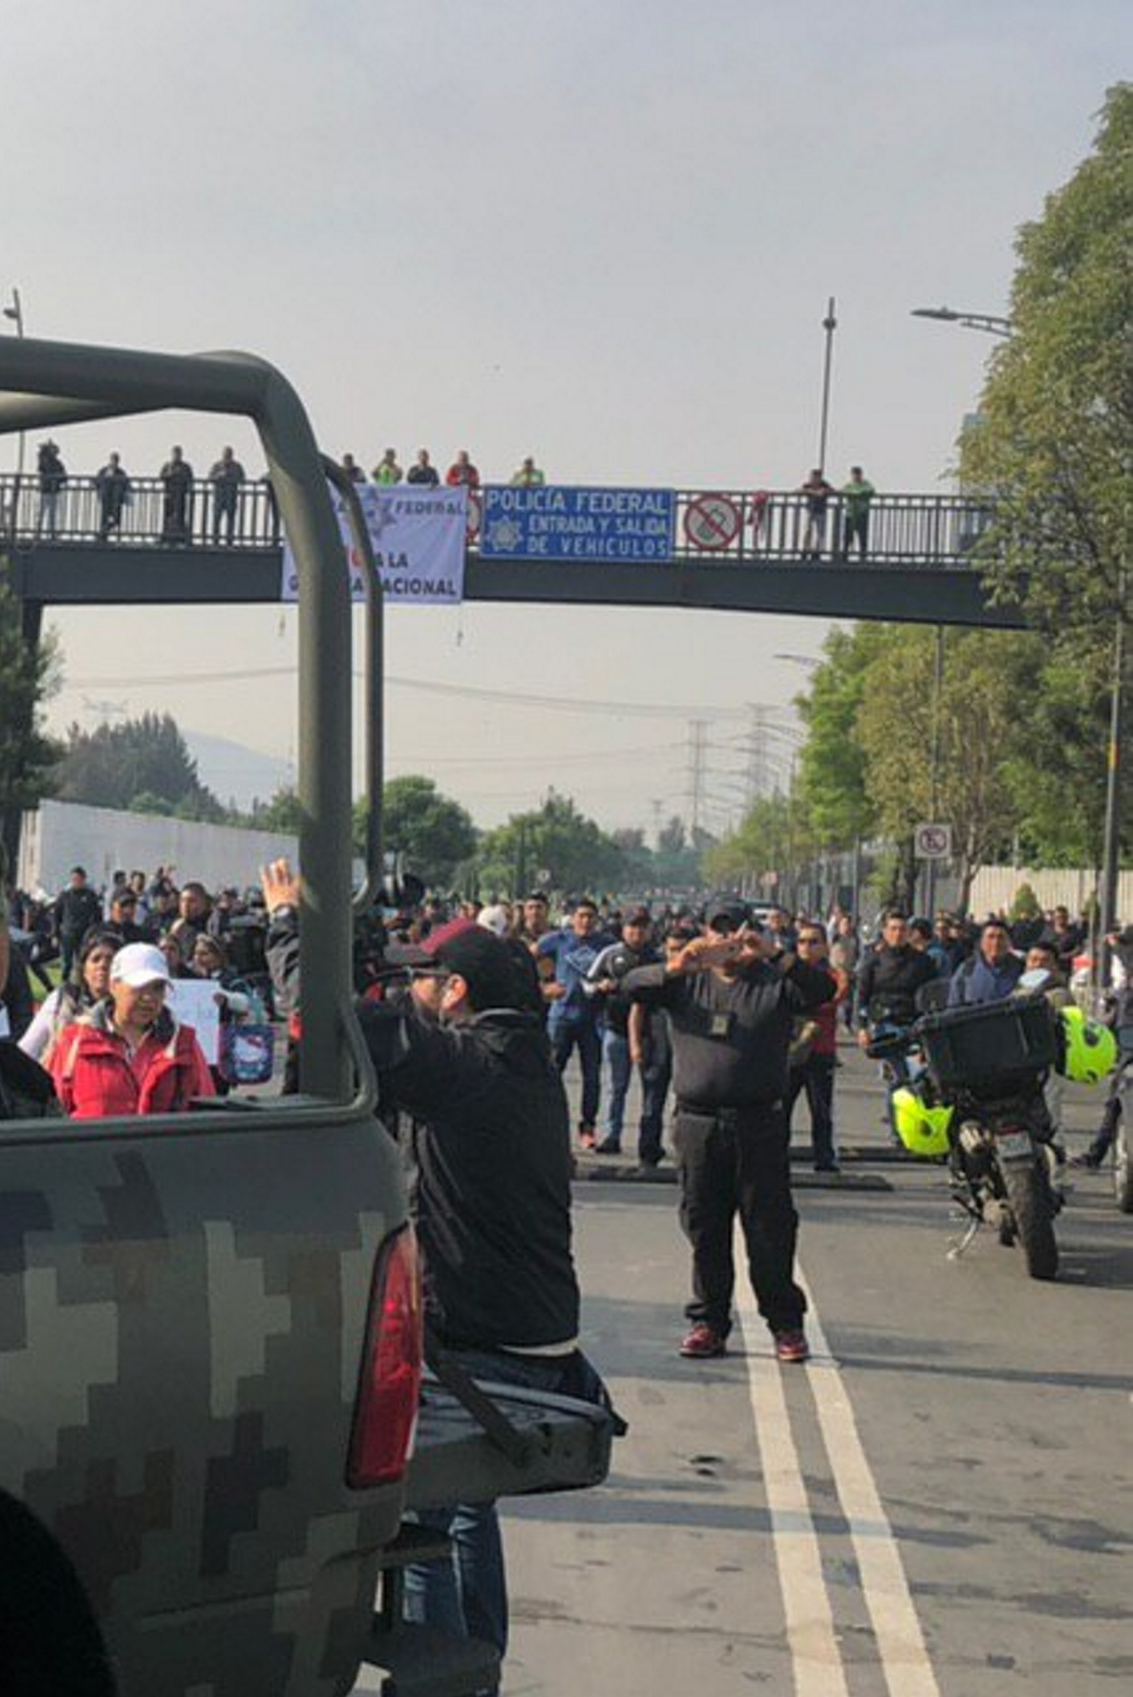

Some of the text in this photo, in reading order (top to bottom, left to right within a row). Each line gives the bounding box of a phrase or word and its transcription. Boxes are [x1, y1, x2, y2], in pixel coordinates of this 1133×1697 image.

[395, 501, 464, 515] FEDERAL
[486, 488, 667, 514] POLICÍA FEDERAL
[528, 514, 667, 536] ENTRADA Y SALIDA
[527, 535, 549, 553] DE
[388, 552, 408, 568] LA
[379, 578, 457, 595] ACIONAL
